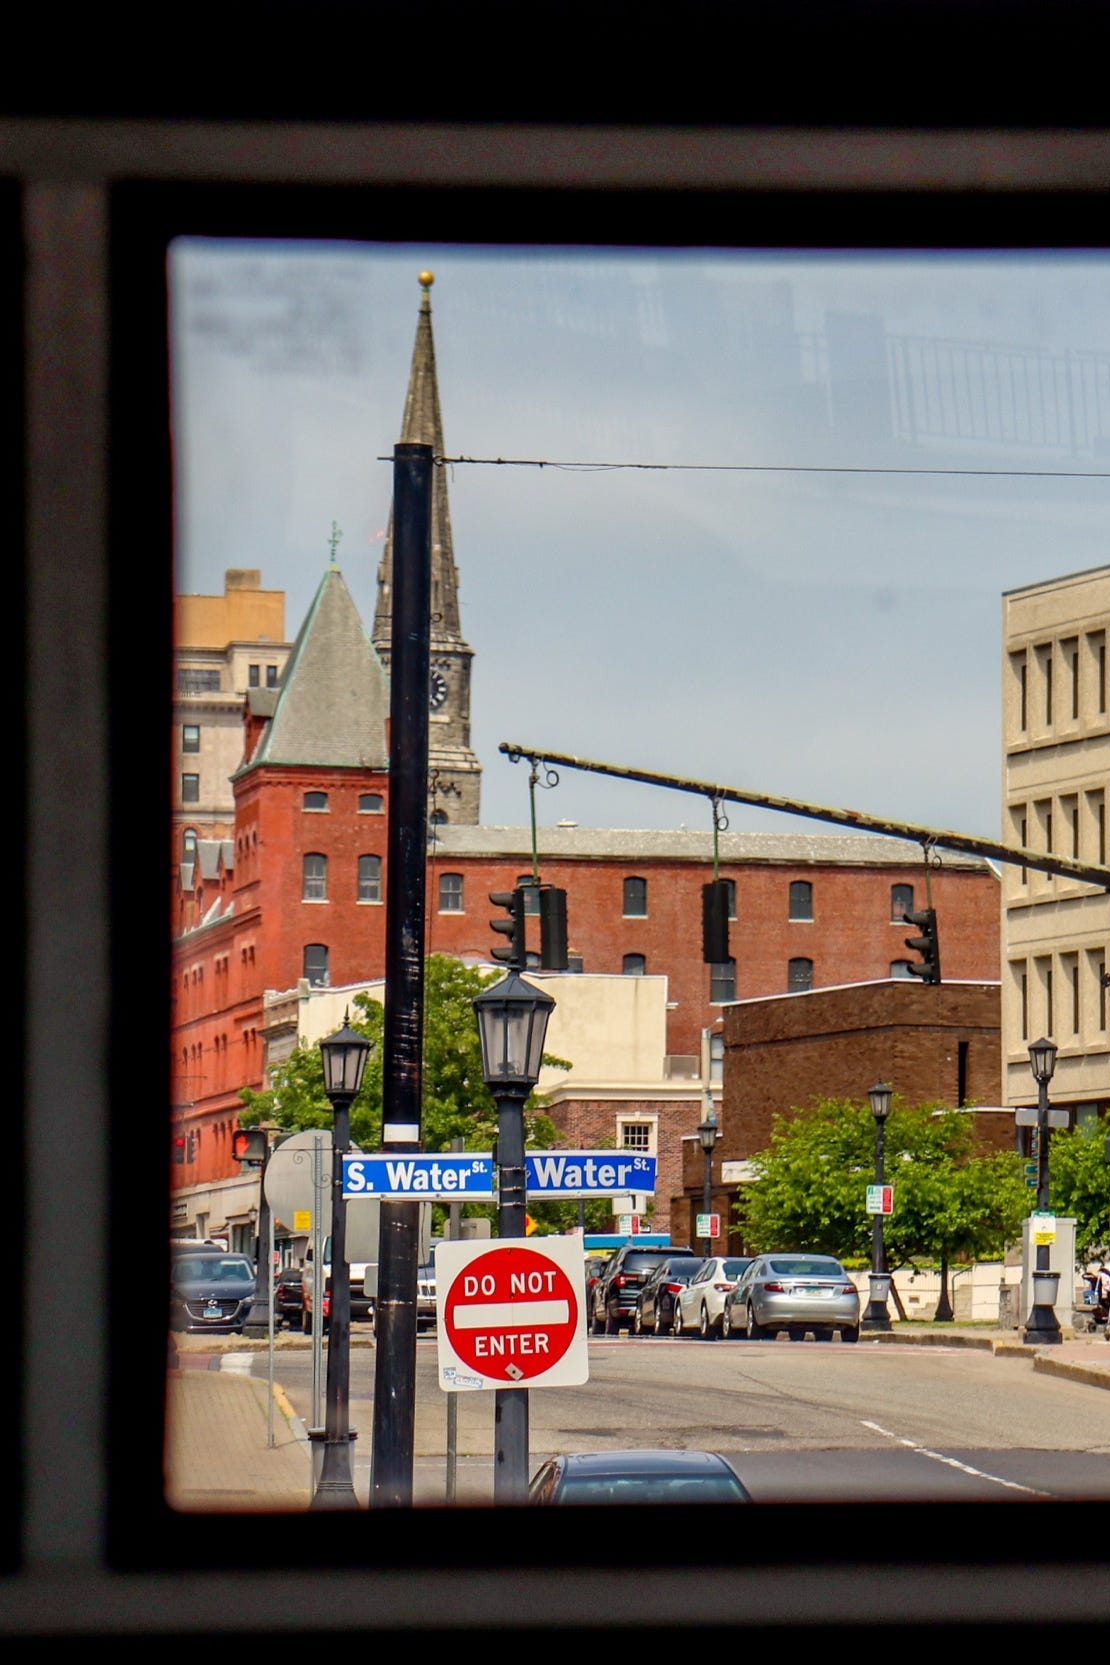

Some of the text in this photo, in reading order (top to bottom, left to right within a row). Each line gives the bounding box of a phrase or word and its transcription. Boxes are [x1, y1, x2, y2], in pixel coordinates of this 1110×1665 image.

[347, 1160, 488, 1191] S. Water St.
[533, 1157, 650, 1187] Water St.
[464, 1271, 556, 1297] DO NOT
[475, 1333, 549, 1357] ENTER
